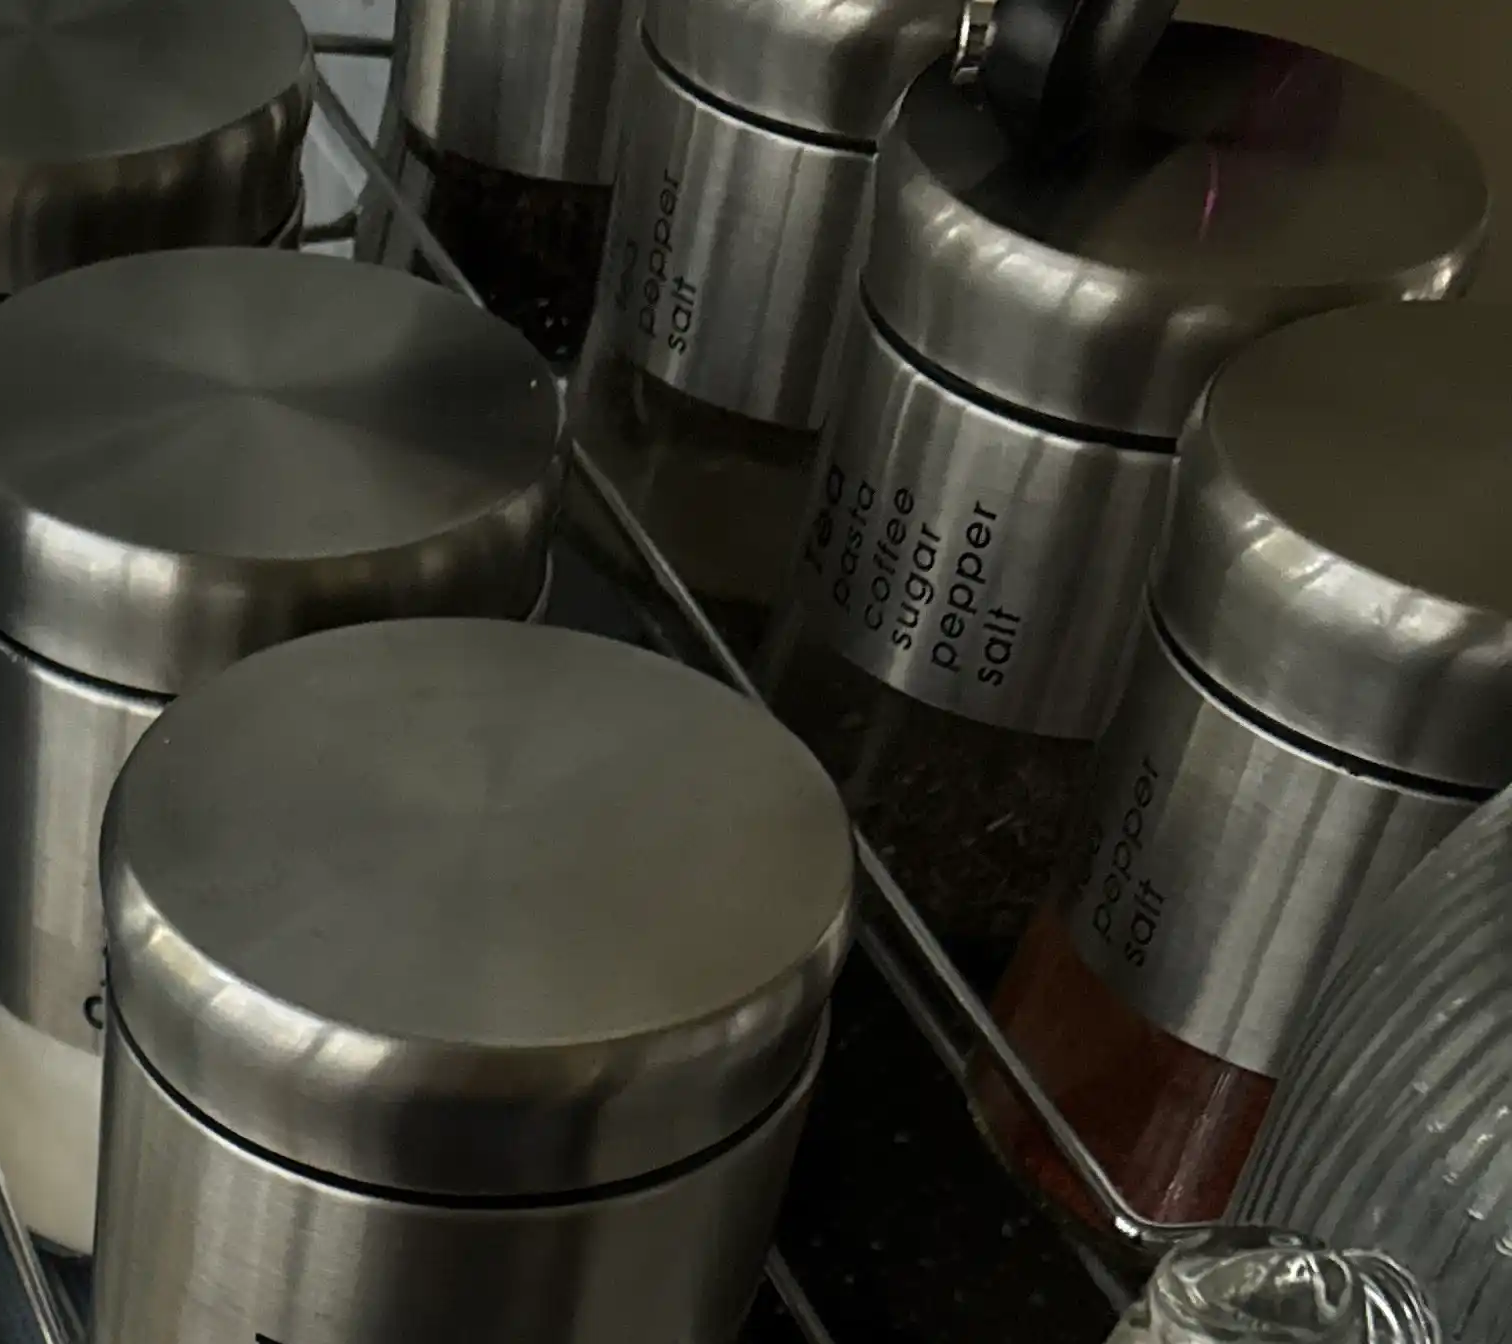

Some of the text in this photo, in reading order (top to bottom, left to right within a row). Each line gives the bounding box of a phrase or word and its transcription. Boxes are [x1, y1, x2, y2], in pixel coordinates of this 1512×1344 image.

[639, 168, 678, 338] pepper
[668, 275, 696, 354] salt
[864, 488, 914, 631] coffee
[892, 523, 941, 650] sugar
[931, 501, 998, 673] pepper
[977, 606, 1021, 687] salt
[1124, 879, 1166, 967] salt
